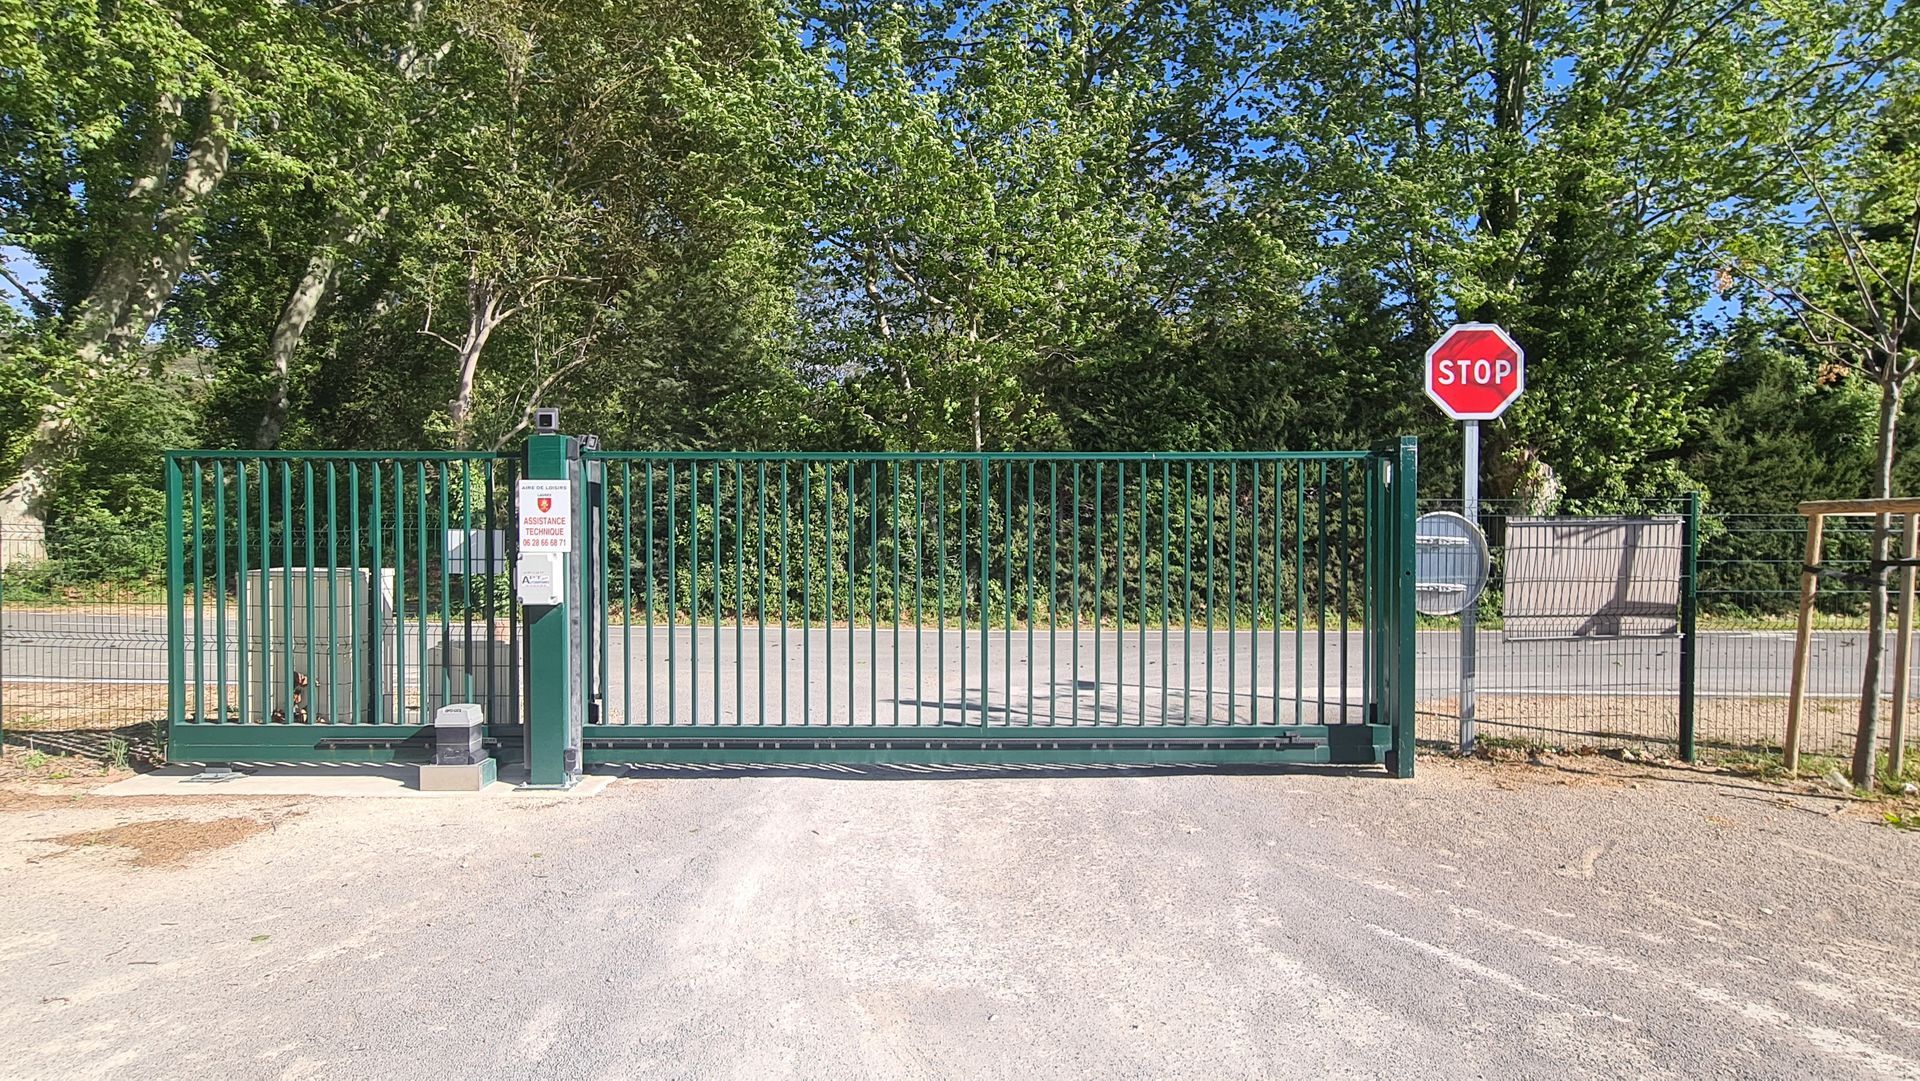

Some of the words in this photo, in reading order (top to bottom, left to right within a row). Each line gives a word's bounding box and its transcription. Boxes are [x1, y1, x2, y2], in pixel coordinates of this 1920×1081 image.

[1438, 359, 1512, 385] STOP
[523, 516, 566, 525] ASSISTANCE
[525, 527, 564, 536] TECHNIQUE
[523, 538, 531, 547] 06
[532, 538, 540, 547] 28
[559, 538, 566, 547] 71
